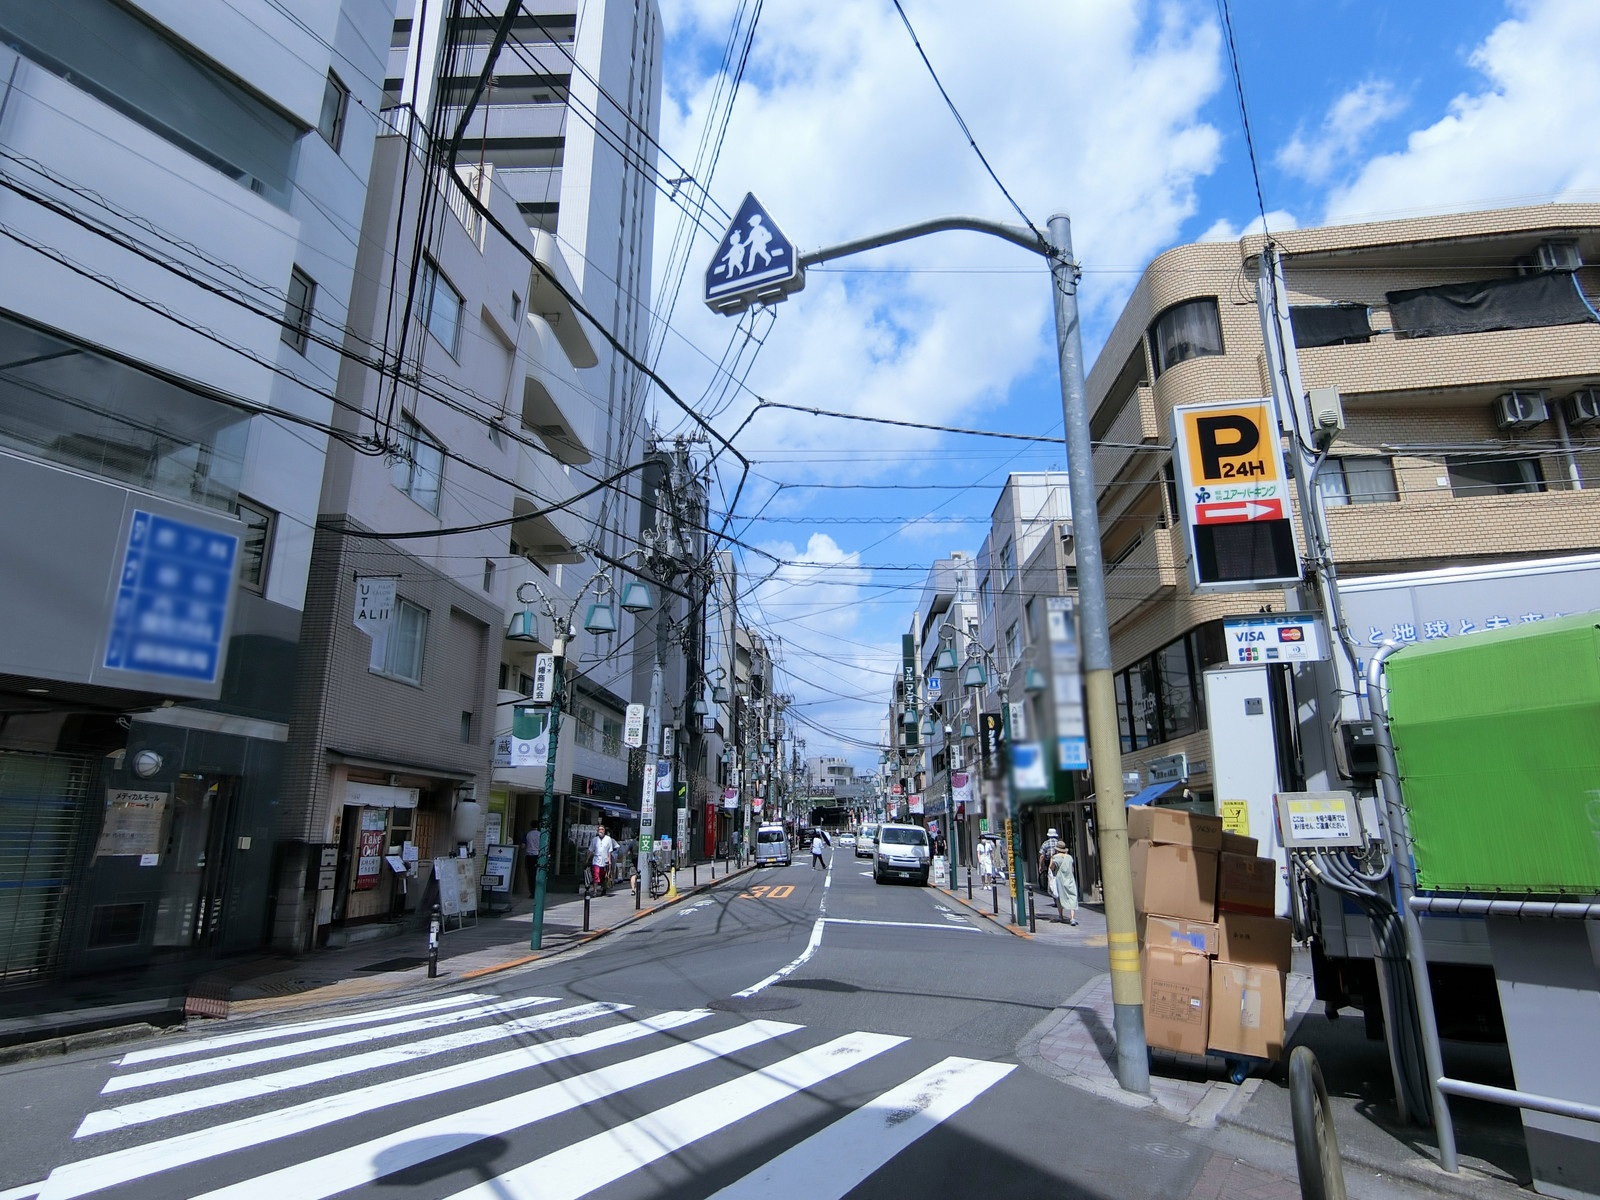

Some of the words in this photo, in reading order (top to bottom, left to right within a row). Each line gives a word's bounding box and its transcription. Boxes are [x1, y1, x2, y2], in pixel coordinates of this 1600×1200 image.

[1197, 415, 1260, 480] P
[1222, 460, 1265, 478] 24H
[1234, 631, 1265, 642] VISA
[536, 658, 547, 699] 八幡商店会
[115, 792, 160, 801] メディカルモール
[363, 833, 382, 844] Take
[363, 844, 380, 856] Out!
[739, 885, 796, 898] 30
